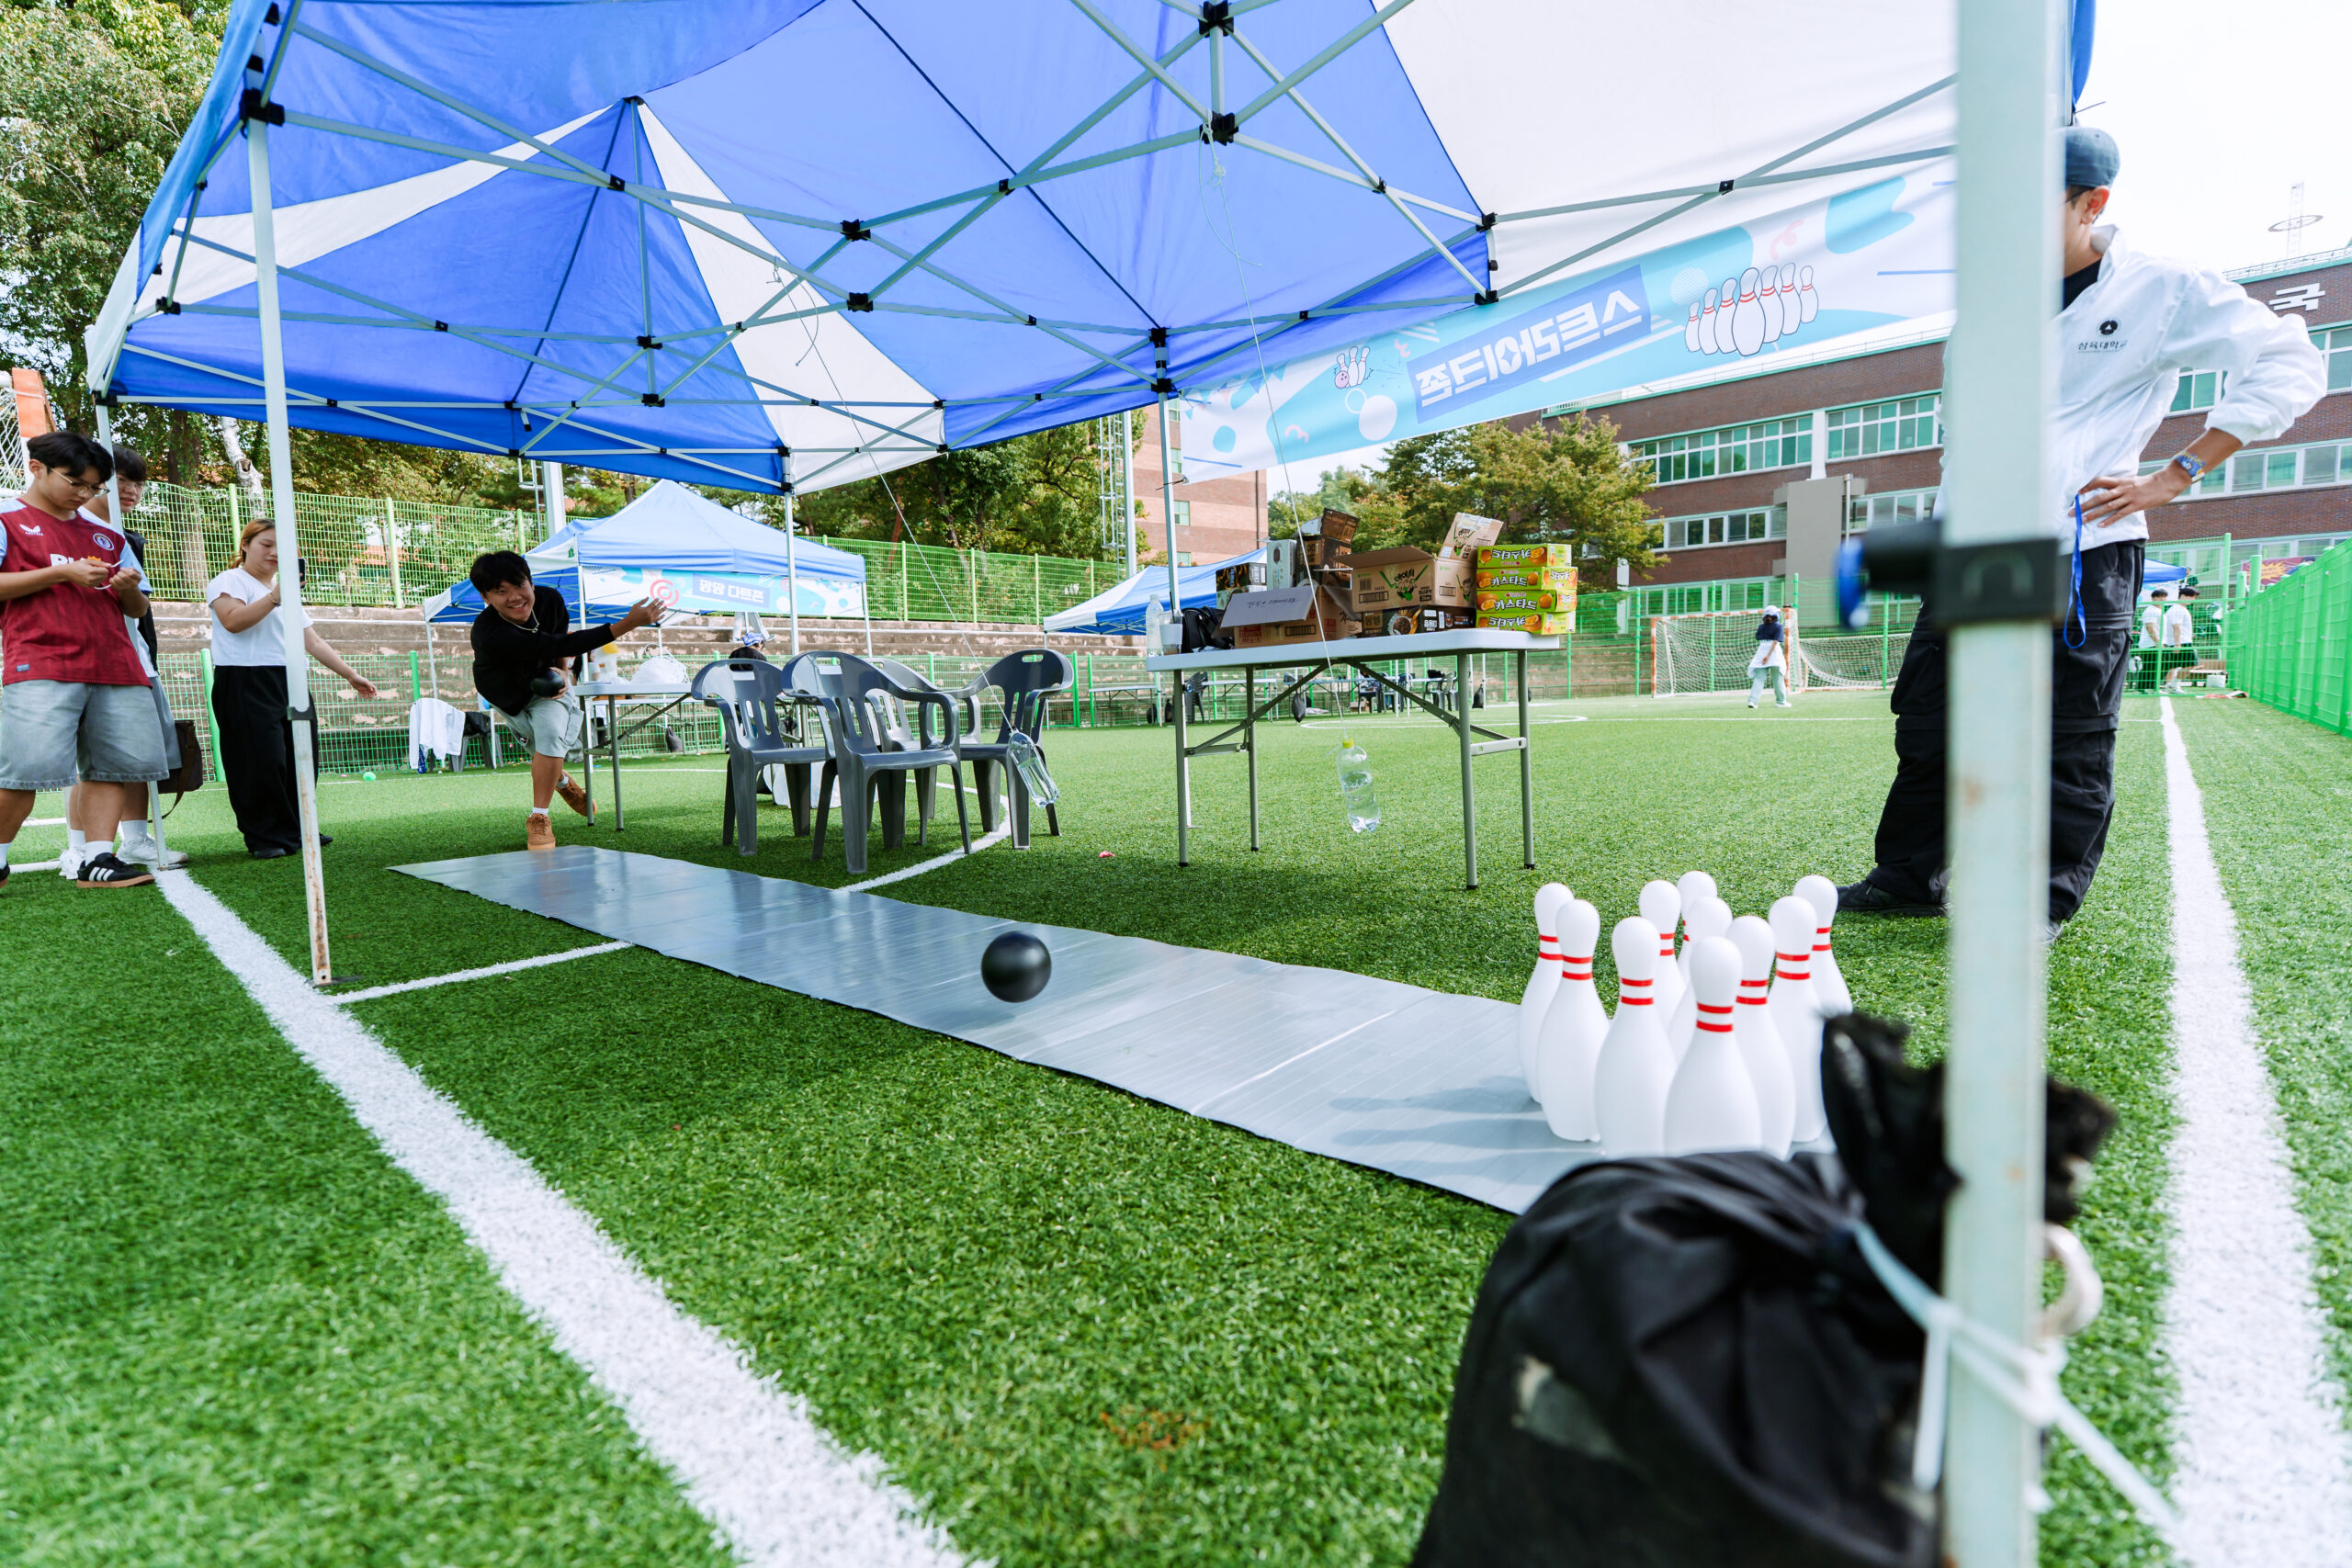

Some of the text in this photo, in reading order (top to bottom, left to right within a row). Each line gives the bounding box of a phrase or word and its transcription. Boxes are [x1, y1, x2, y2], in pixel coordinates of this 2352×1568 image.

[2268, 282, 2326, 311] 국
[1491, 548, 1532, 560] 카스타드
[1490, 575, 1528, 587] 카스타드
[727, 584, 764, 604] 다트존
[1494, 598, 1538, 611] 카스타드
[1488, 615, 1526, 627] 카스타드
